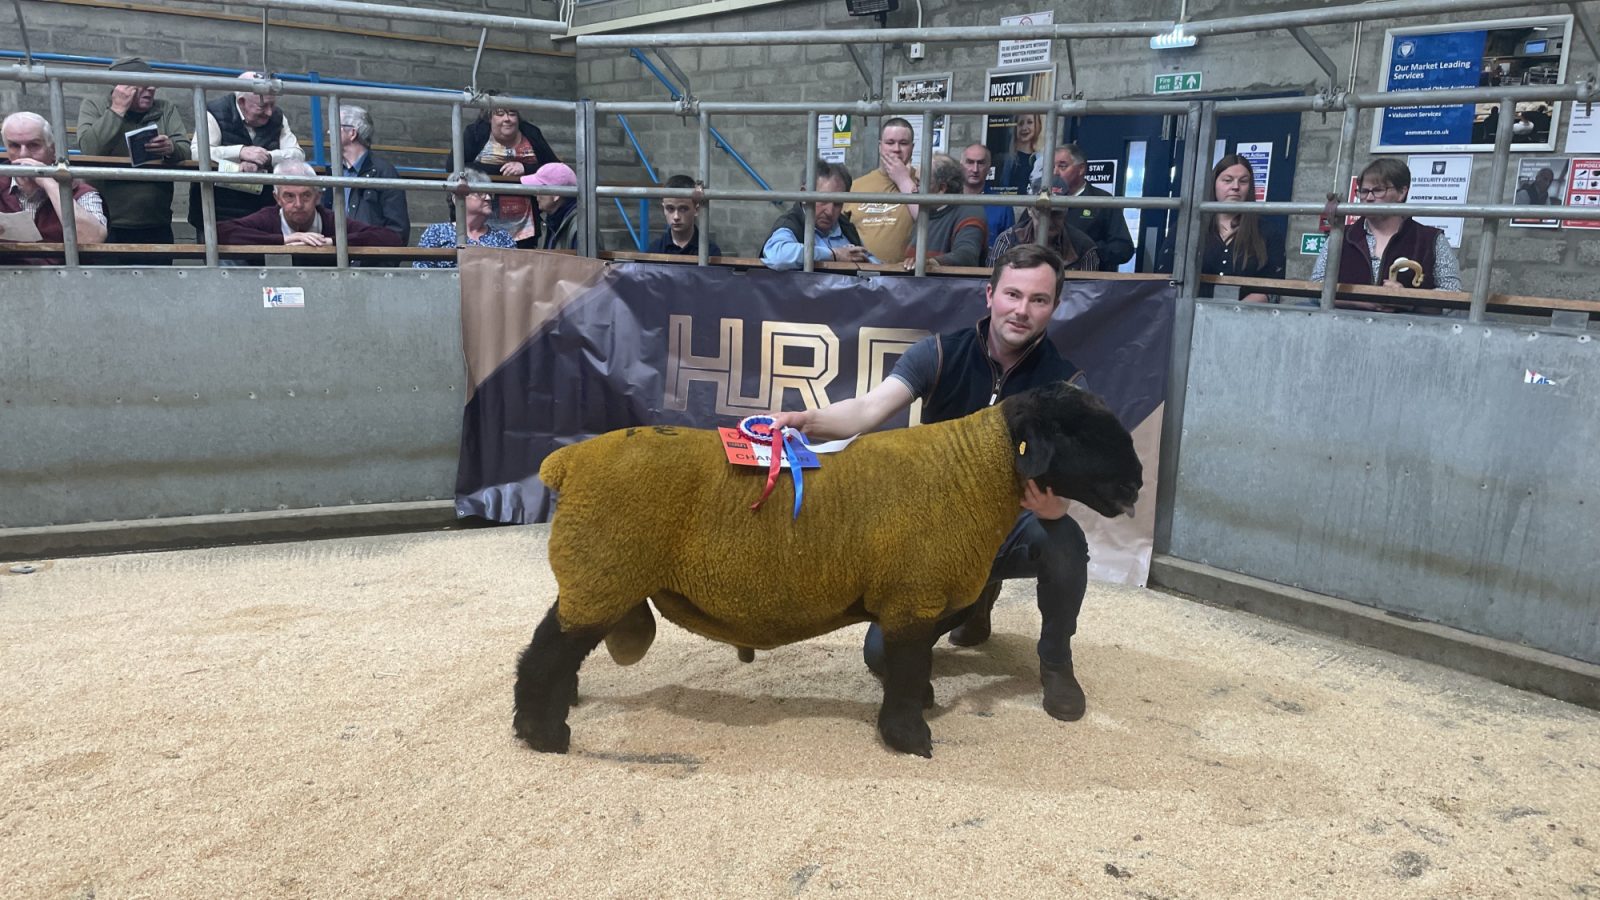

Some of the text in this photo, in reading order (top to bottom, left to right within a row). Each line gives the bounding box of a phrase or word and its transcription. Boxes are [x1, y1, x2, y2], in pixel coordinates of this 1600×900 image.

[1394, 60, 1471, 72] Our Market Leading
[1393, 72, 1425, 80] Services
[990, 81, 1024, 97] INVEST IN
[1088, 164, 1105, 172] STAY
